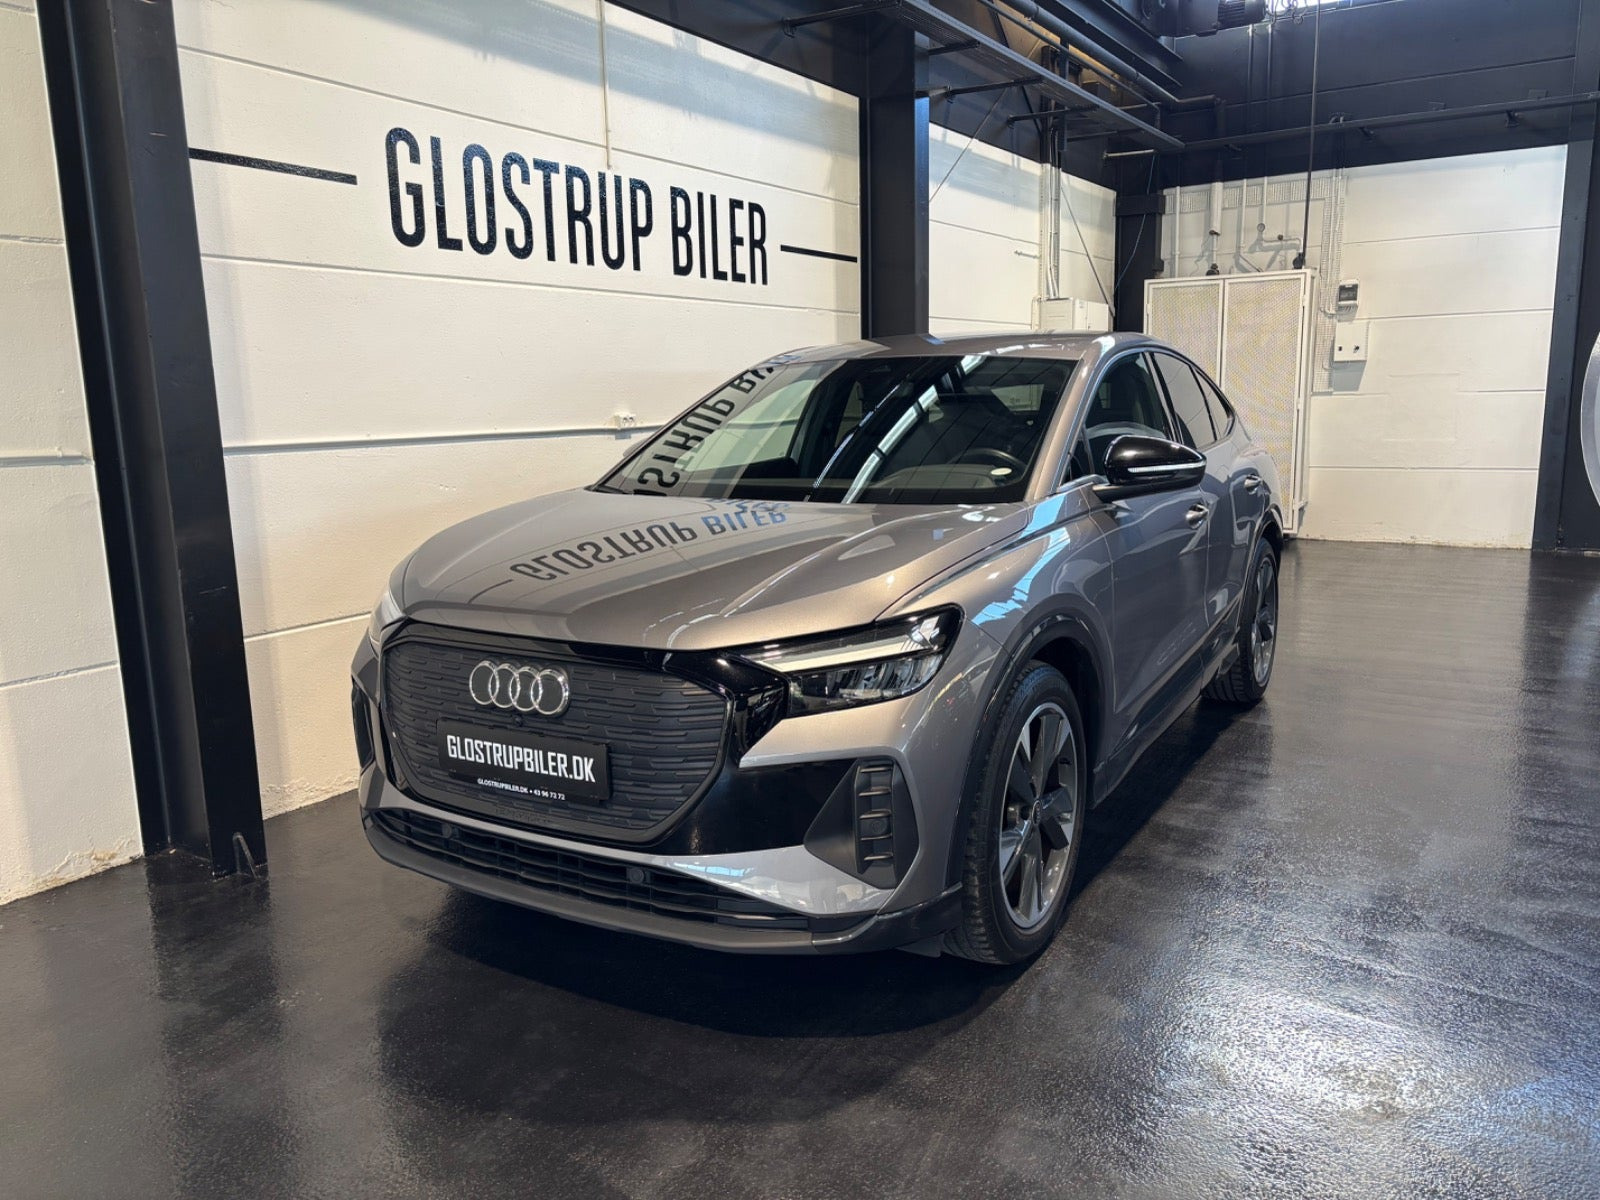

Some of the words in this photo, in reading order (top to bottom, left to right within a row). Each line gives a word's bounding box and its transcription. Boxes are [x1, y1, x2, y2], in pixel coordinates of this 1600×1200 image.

[385, 127, 653, 271] GLOSTRUP
[670, 185, 768, 286] BILER
[446, 735, 596, 783] GLOSTRUPBILER.DK
[477, 778, 529, 794] GLOSTRUPBILER.DK
